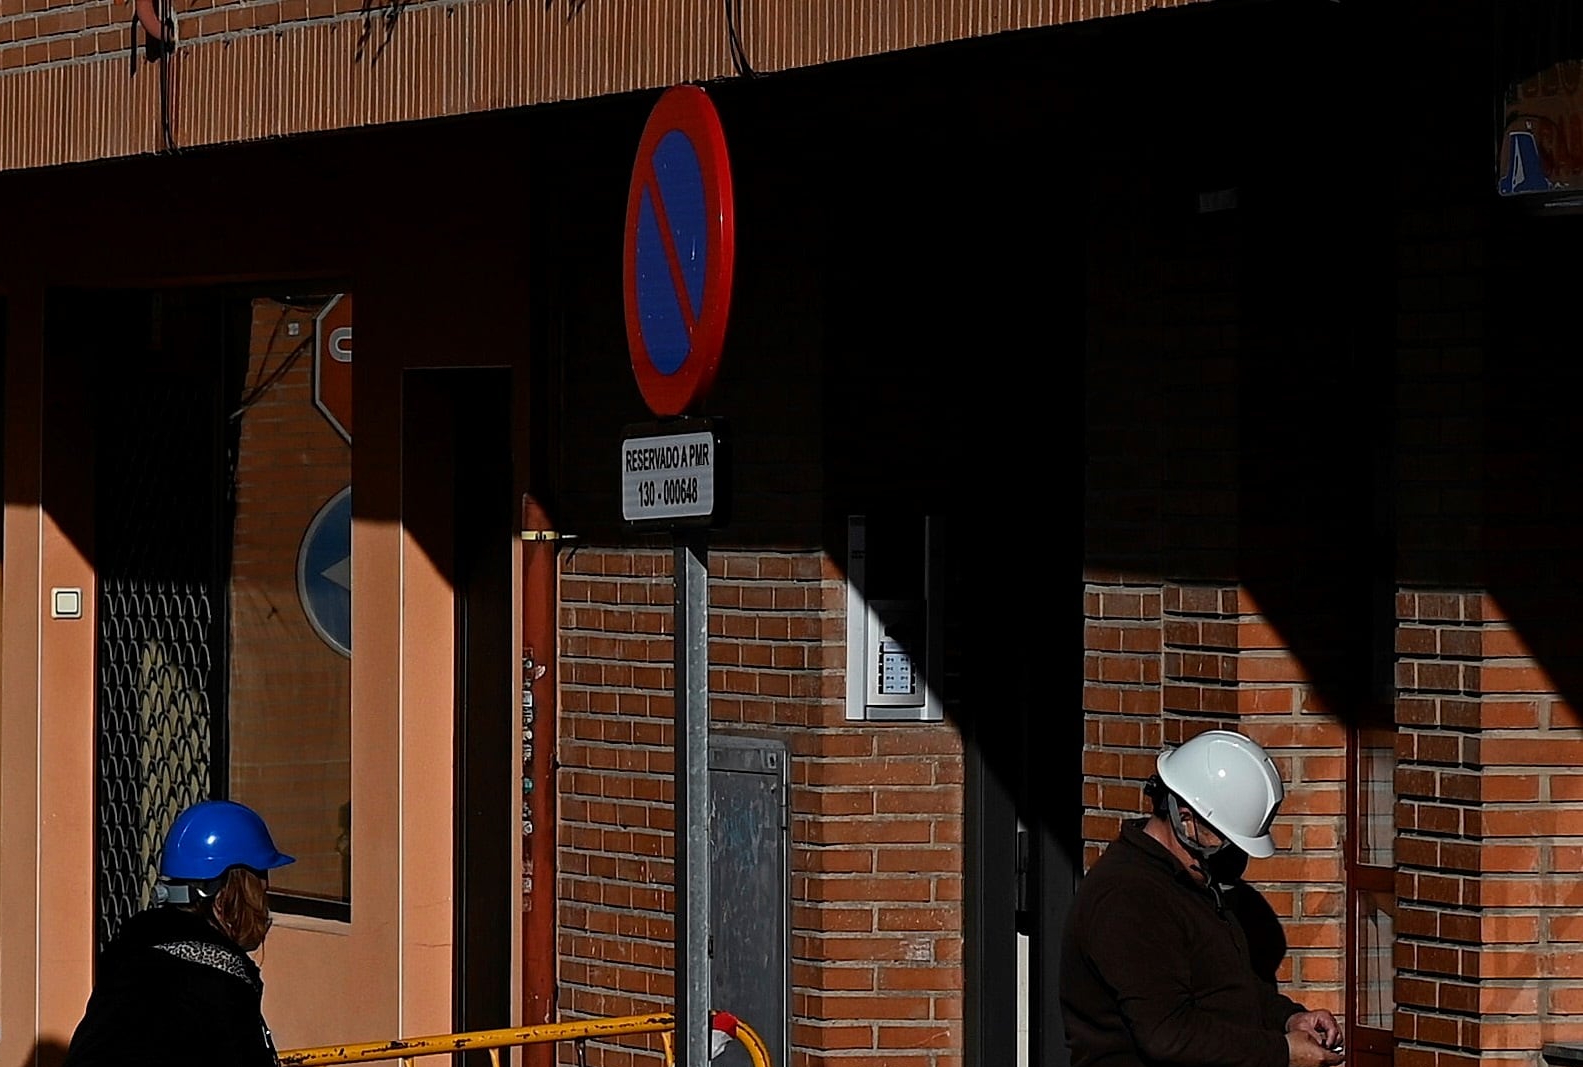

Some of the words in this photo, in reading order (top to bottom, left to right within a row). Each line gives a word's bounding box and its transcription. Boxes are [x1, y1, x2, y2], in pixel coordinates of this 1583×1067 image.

[626, 446, 679, 472] RESERVADO
[681, 446, 688, 467] A
[689, 444, 709, 467] PMR
[639, 481, 655, 507] 130
[664, 478, 697, 505] 000648
